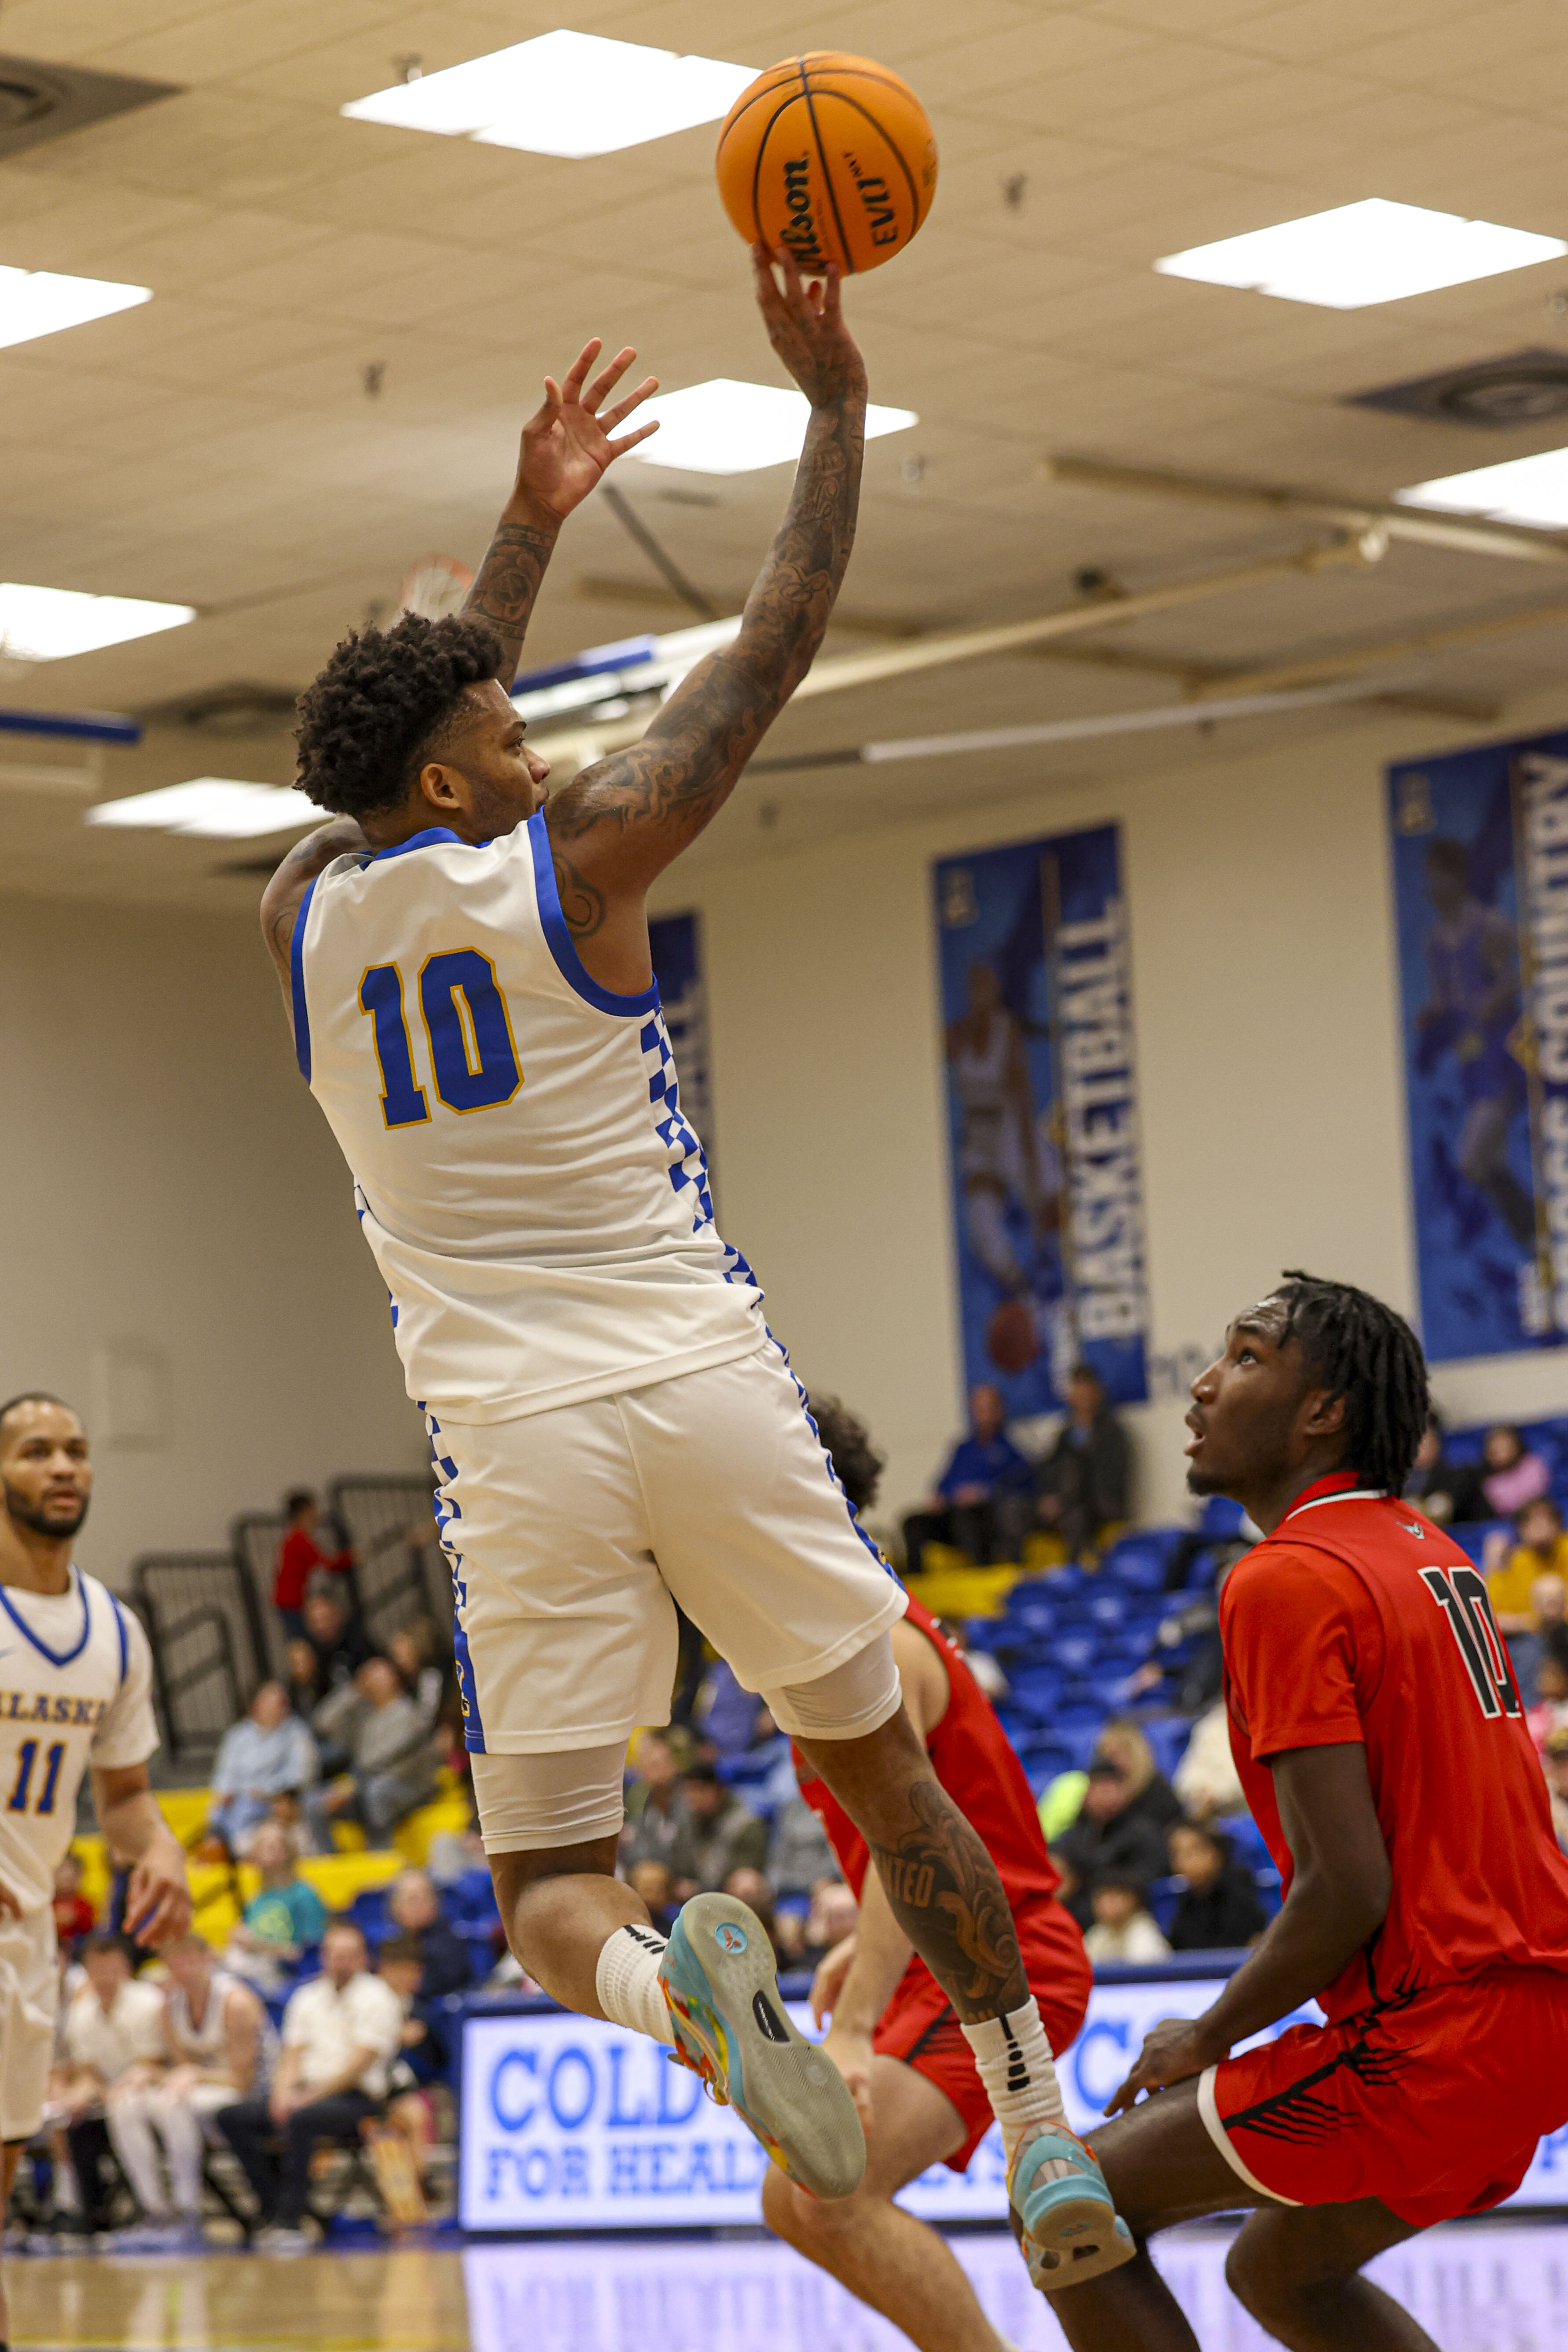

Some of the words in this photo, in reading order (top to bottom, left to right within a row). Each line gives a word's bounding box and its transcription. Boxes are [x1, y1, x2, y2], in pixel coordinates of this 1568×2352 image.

[857, 177, 898, 246] EVO
[358, 946, 525, 1130] 10
[1056, 899, 1143, 1341] BASKETBALL
[1417, 1566, 1521, 1719] 10
[0, 1689, 107, 1726] LASK
[7, 1737, 66, 1815] 11
[490, 2046, 703, 2130] COLD
[487, 2147, 589, 2200] FOR
